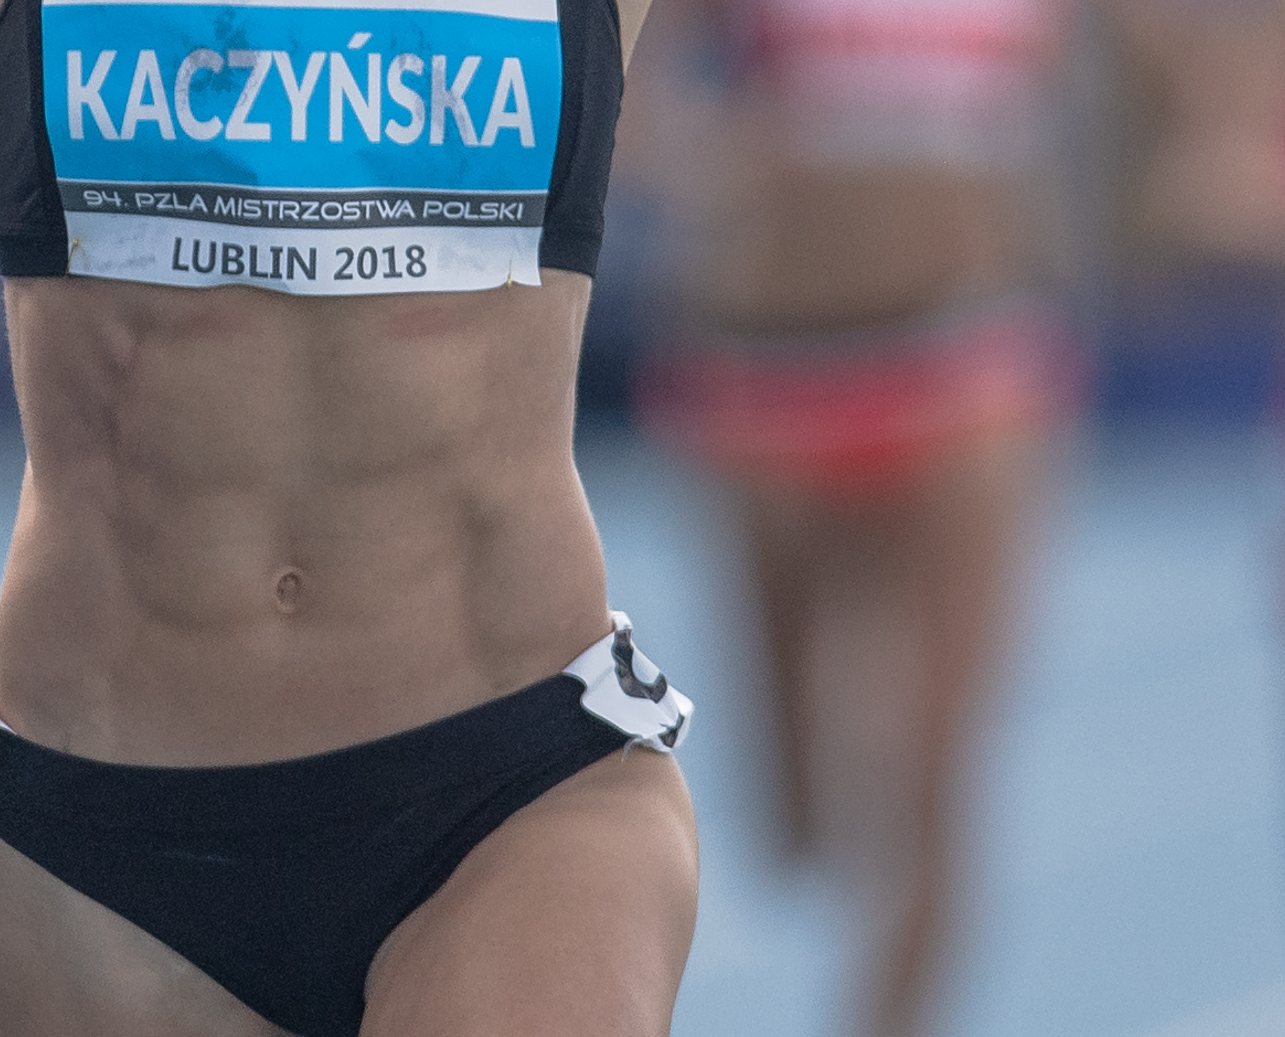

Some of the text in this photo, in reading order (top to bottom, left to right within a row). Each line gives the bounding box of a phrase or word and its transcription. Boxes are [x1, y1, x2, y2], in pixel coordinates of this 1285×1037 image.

[66, 32, 536, 149] KACZYŃSKA
[82, 190, 524, 220] 94. PZLA MISTRZOSTWA POLSKI
[172, 237, 428, 281] LUBLIN 2018
